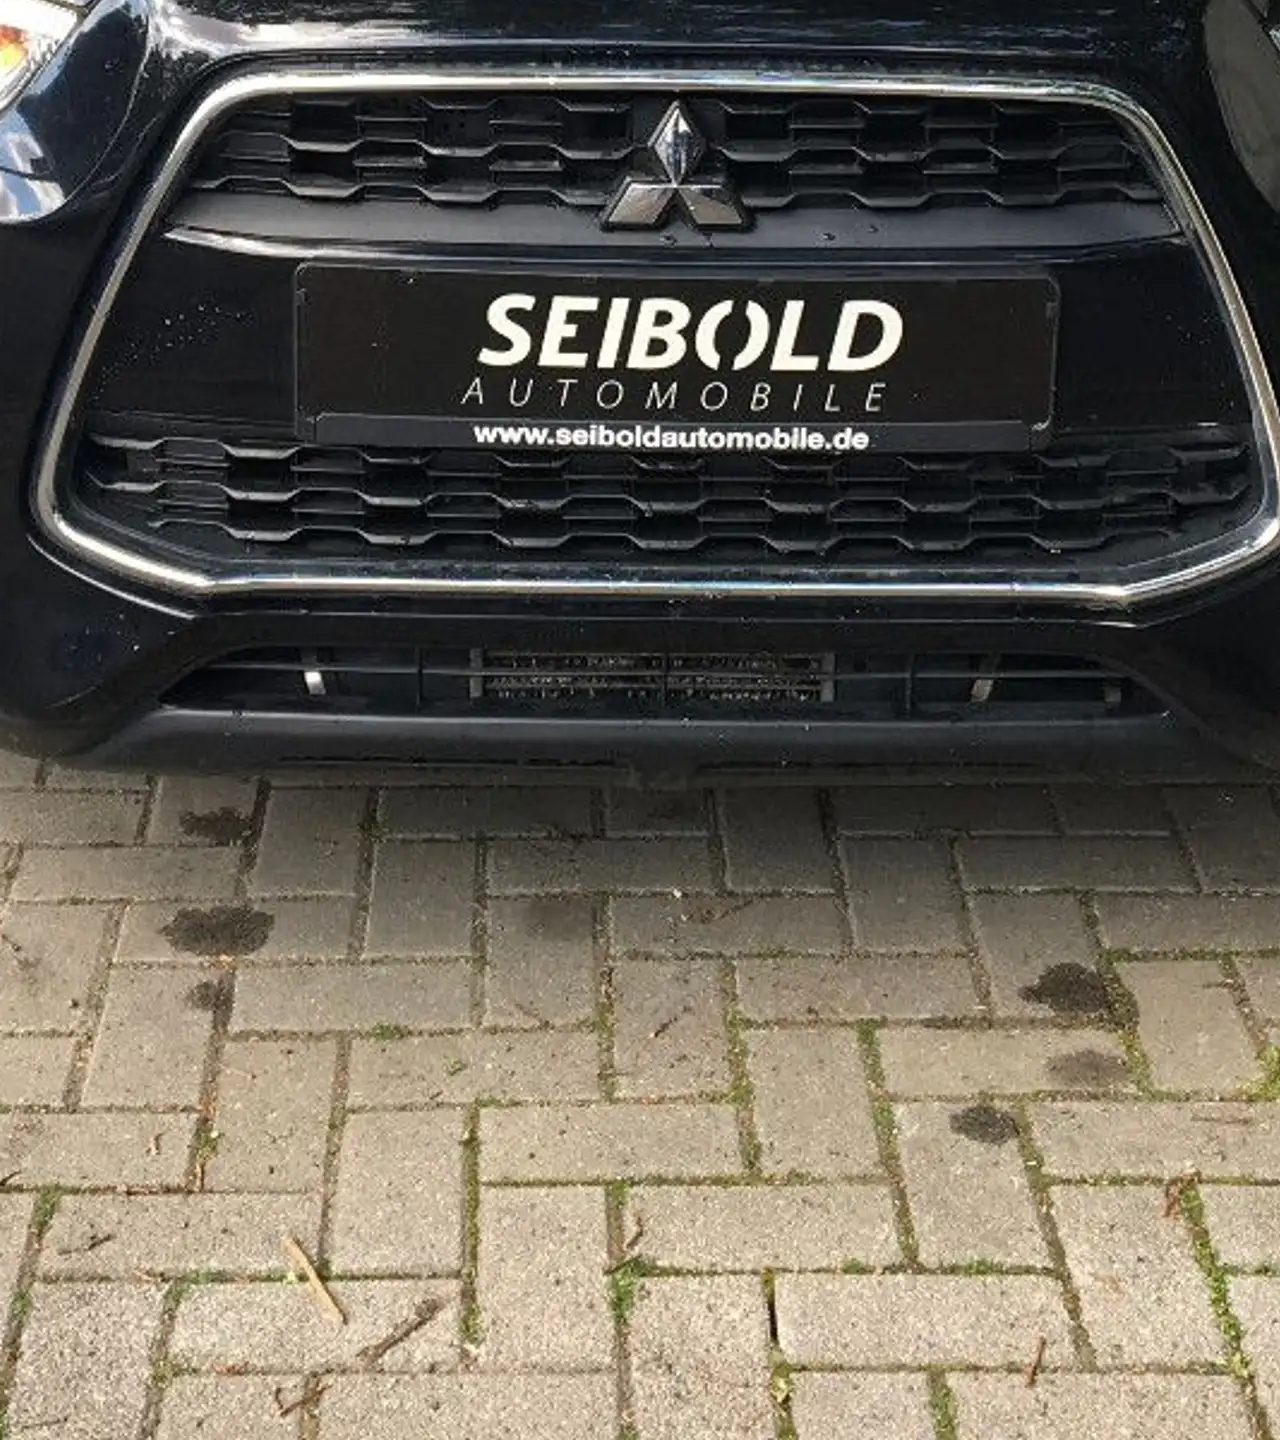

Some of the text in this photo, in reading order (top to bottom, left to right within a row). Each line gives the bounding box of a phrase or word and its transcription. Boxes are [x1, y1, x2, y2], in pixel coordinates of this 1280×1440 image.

[478, 294, 904, 372] SEIBOLD
[461, 377, 887, 413] AUTOMOBILE
[474, 422, 869, 451] www.seiboldautomobile.de
